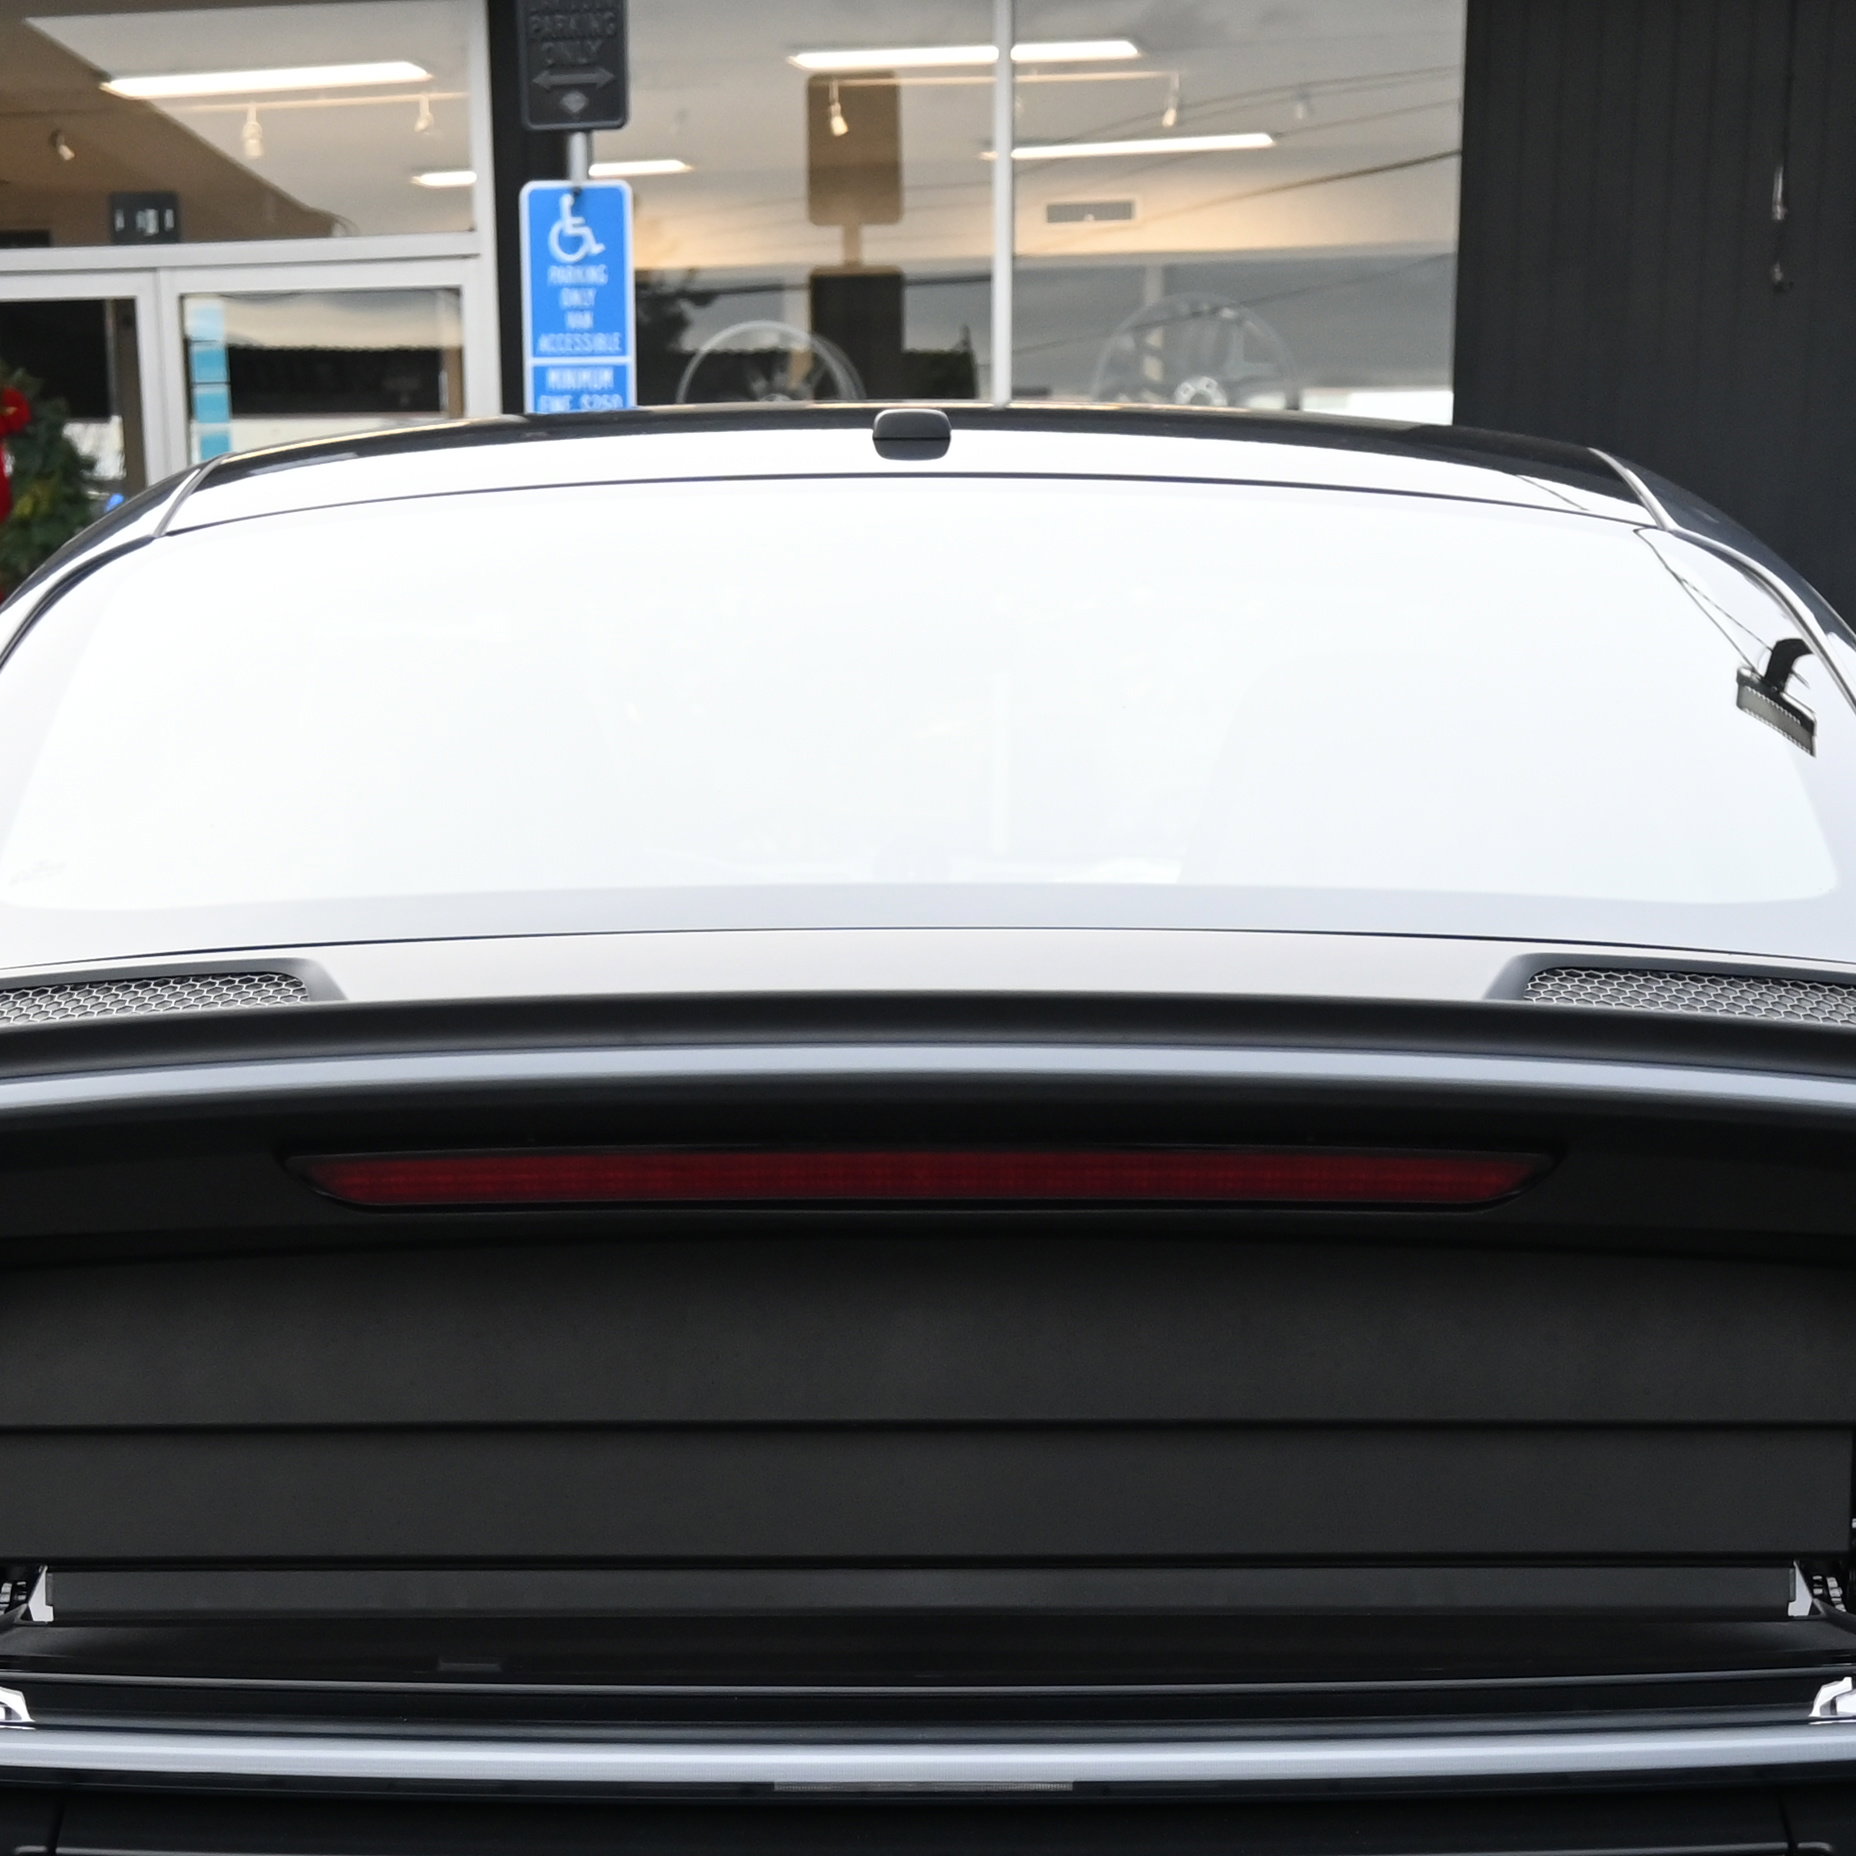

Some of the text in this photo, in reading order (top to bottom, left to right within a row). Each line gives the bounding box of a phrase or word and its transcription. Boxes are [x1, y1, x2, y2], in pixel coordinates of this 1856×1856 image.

[529, 11, 616, 38] PARKING
[547, 264, 609, 286] PARKING
[537, 331, 623, 354] ACCESSIBLE
[545, 366, 614, 391] MINIMUM
